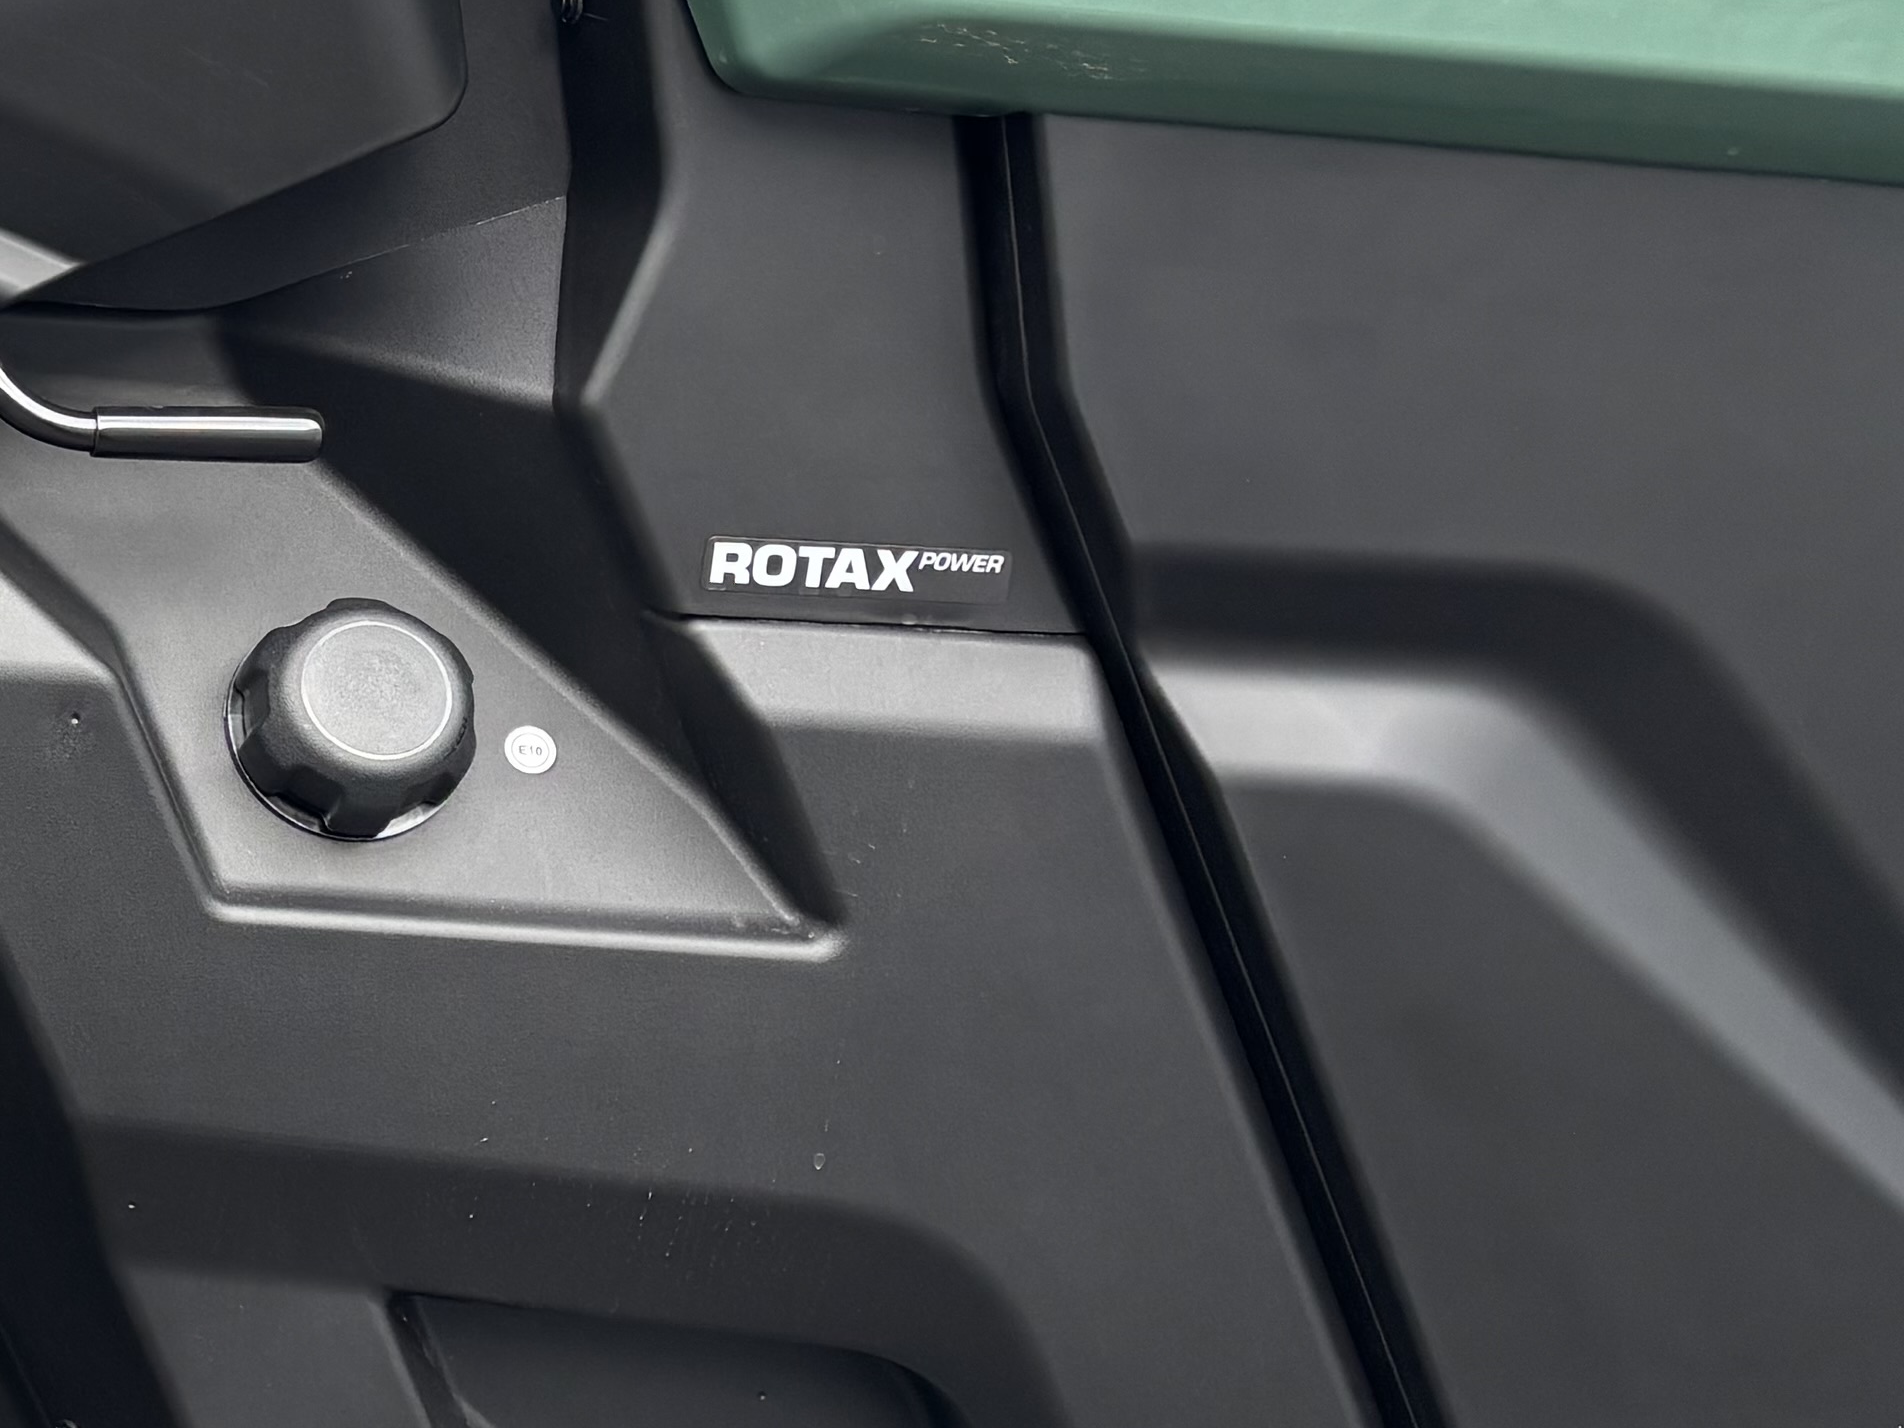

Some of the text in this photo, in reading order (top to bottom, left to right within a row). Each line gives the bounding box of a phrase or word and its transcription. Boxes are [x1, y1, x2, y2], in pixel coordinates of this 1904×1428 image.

[709, 541, 1004, 592] ROTAX POWER
[518, 744, 543, 756] E10
